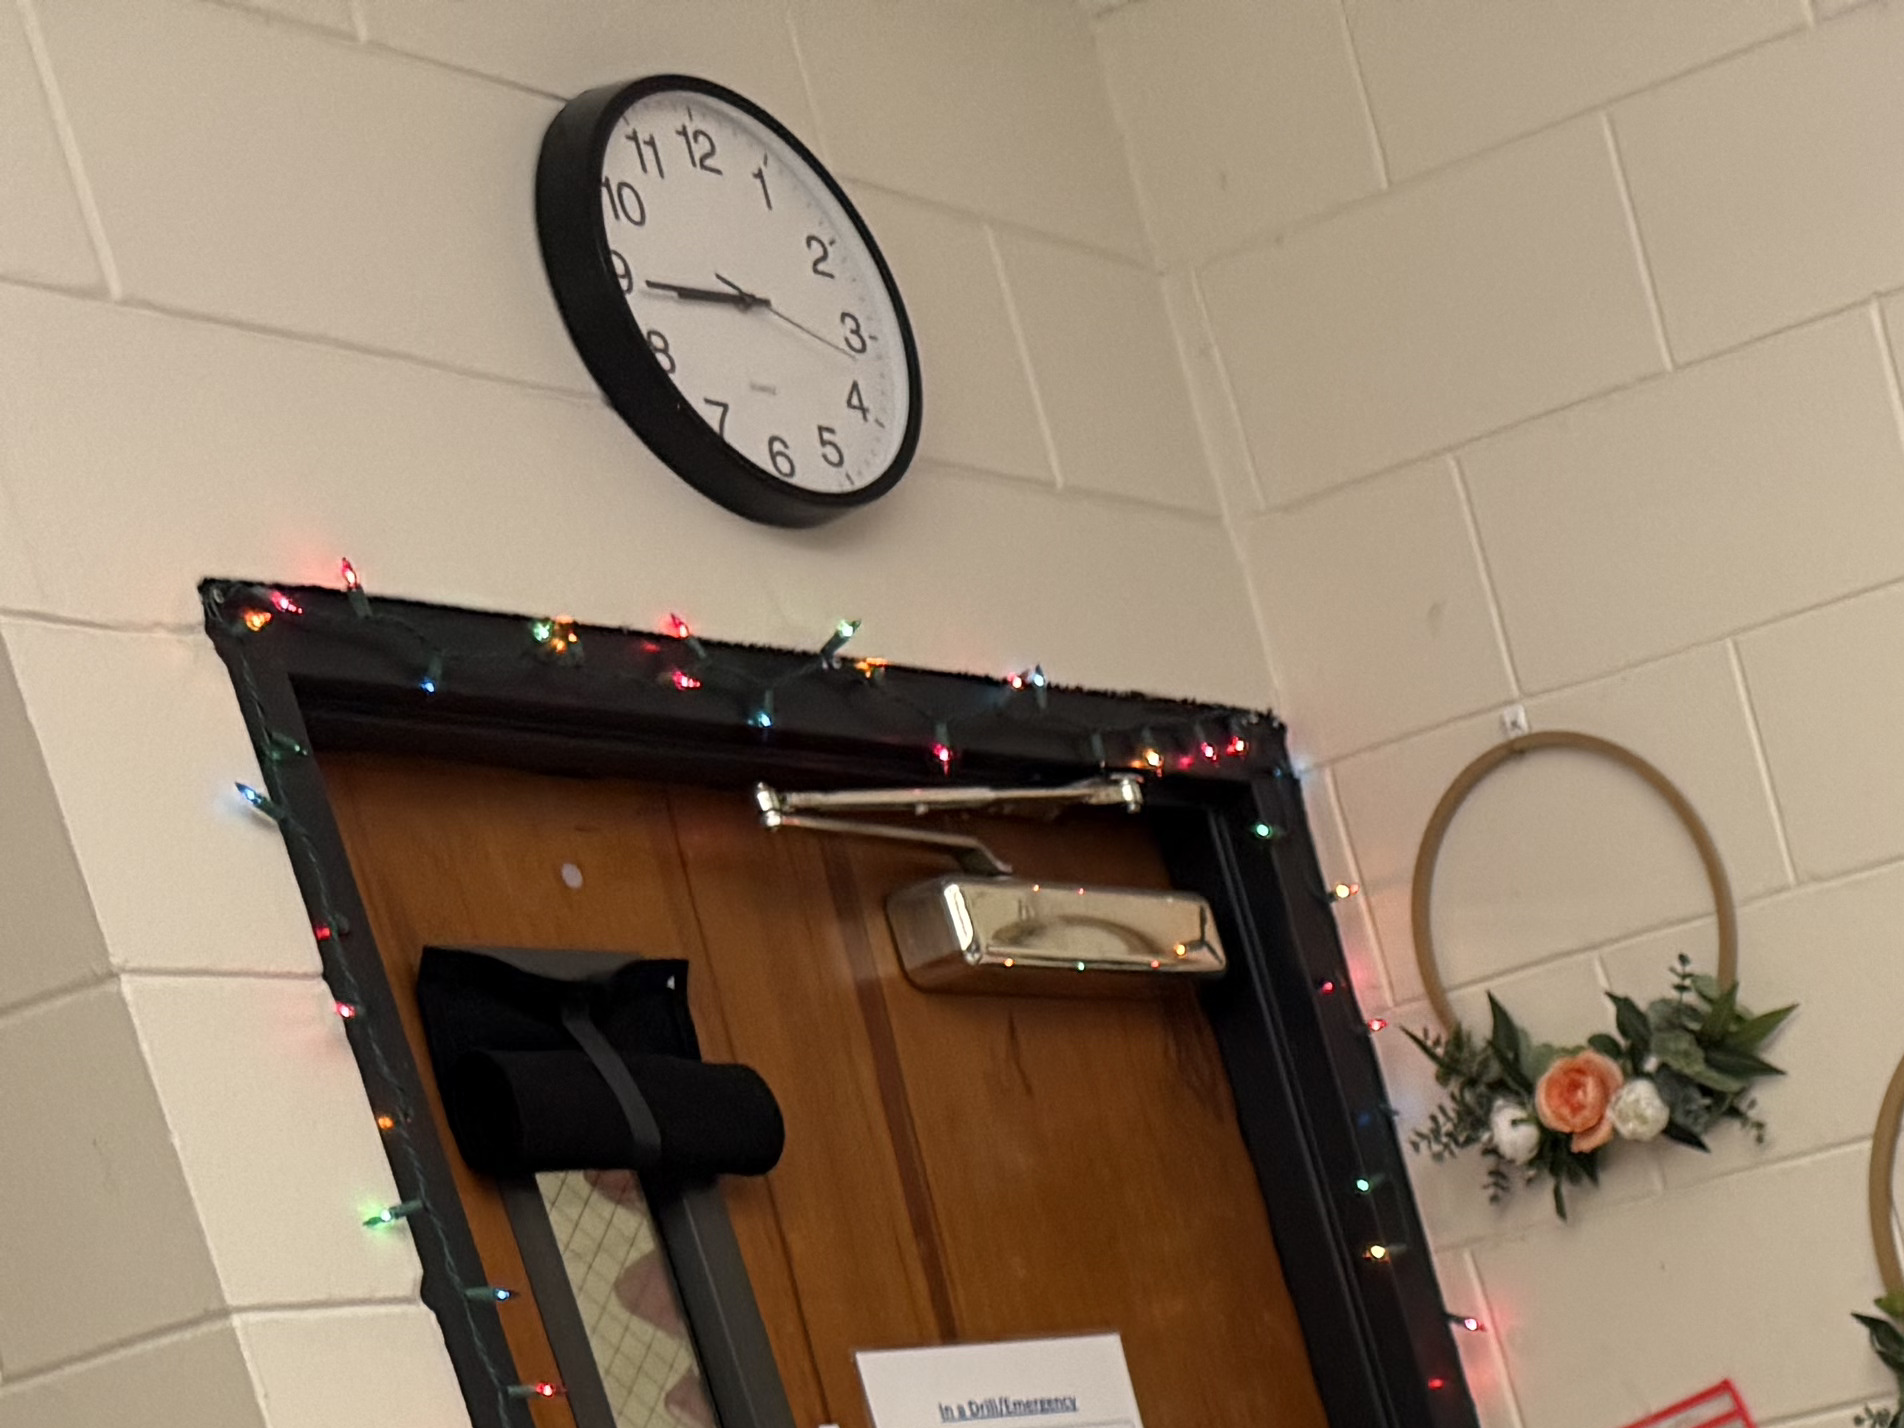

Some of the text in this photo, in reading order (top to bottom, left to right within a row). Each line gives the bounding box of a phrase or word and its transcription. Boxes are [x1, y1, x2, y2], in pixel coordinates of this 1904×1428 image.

[625, 129, 664, 178] 11
[676, 124, 722, 175] 12
[601, 176, 645, 226] 10
[752, 166, 772, 210] 1
[609, 249, 633, 293] 9
[806, 235, 835, 279] 2
[646, 331, 676, 375] 8
[840, 312, 866, 354] 3
[704, 398, 729, 439] 7
[846, 380, 870, 422] 4
[768, 435, 796, 478] 6
[817, 425, 844, 467] 5
